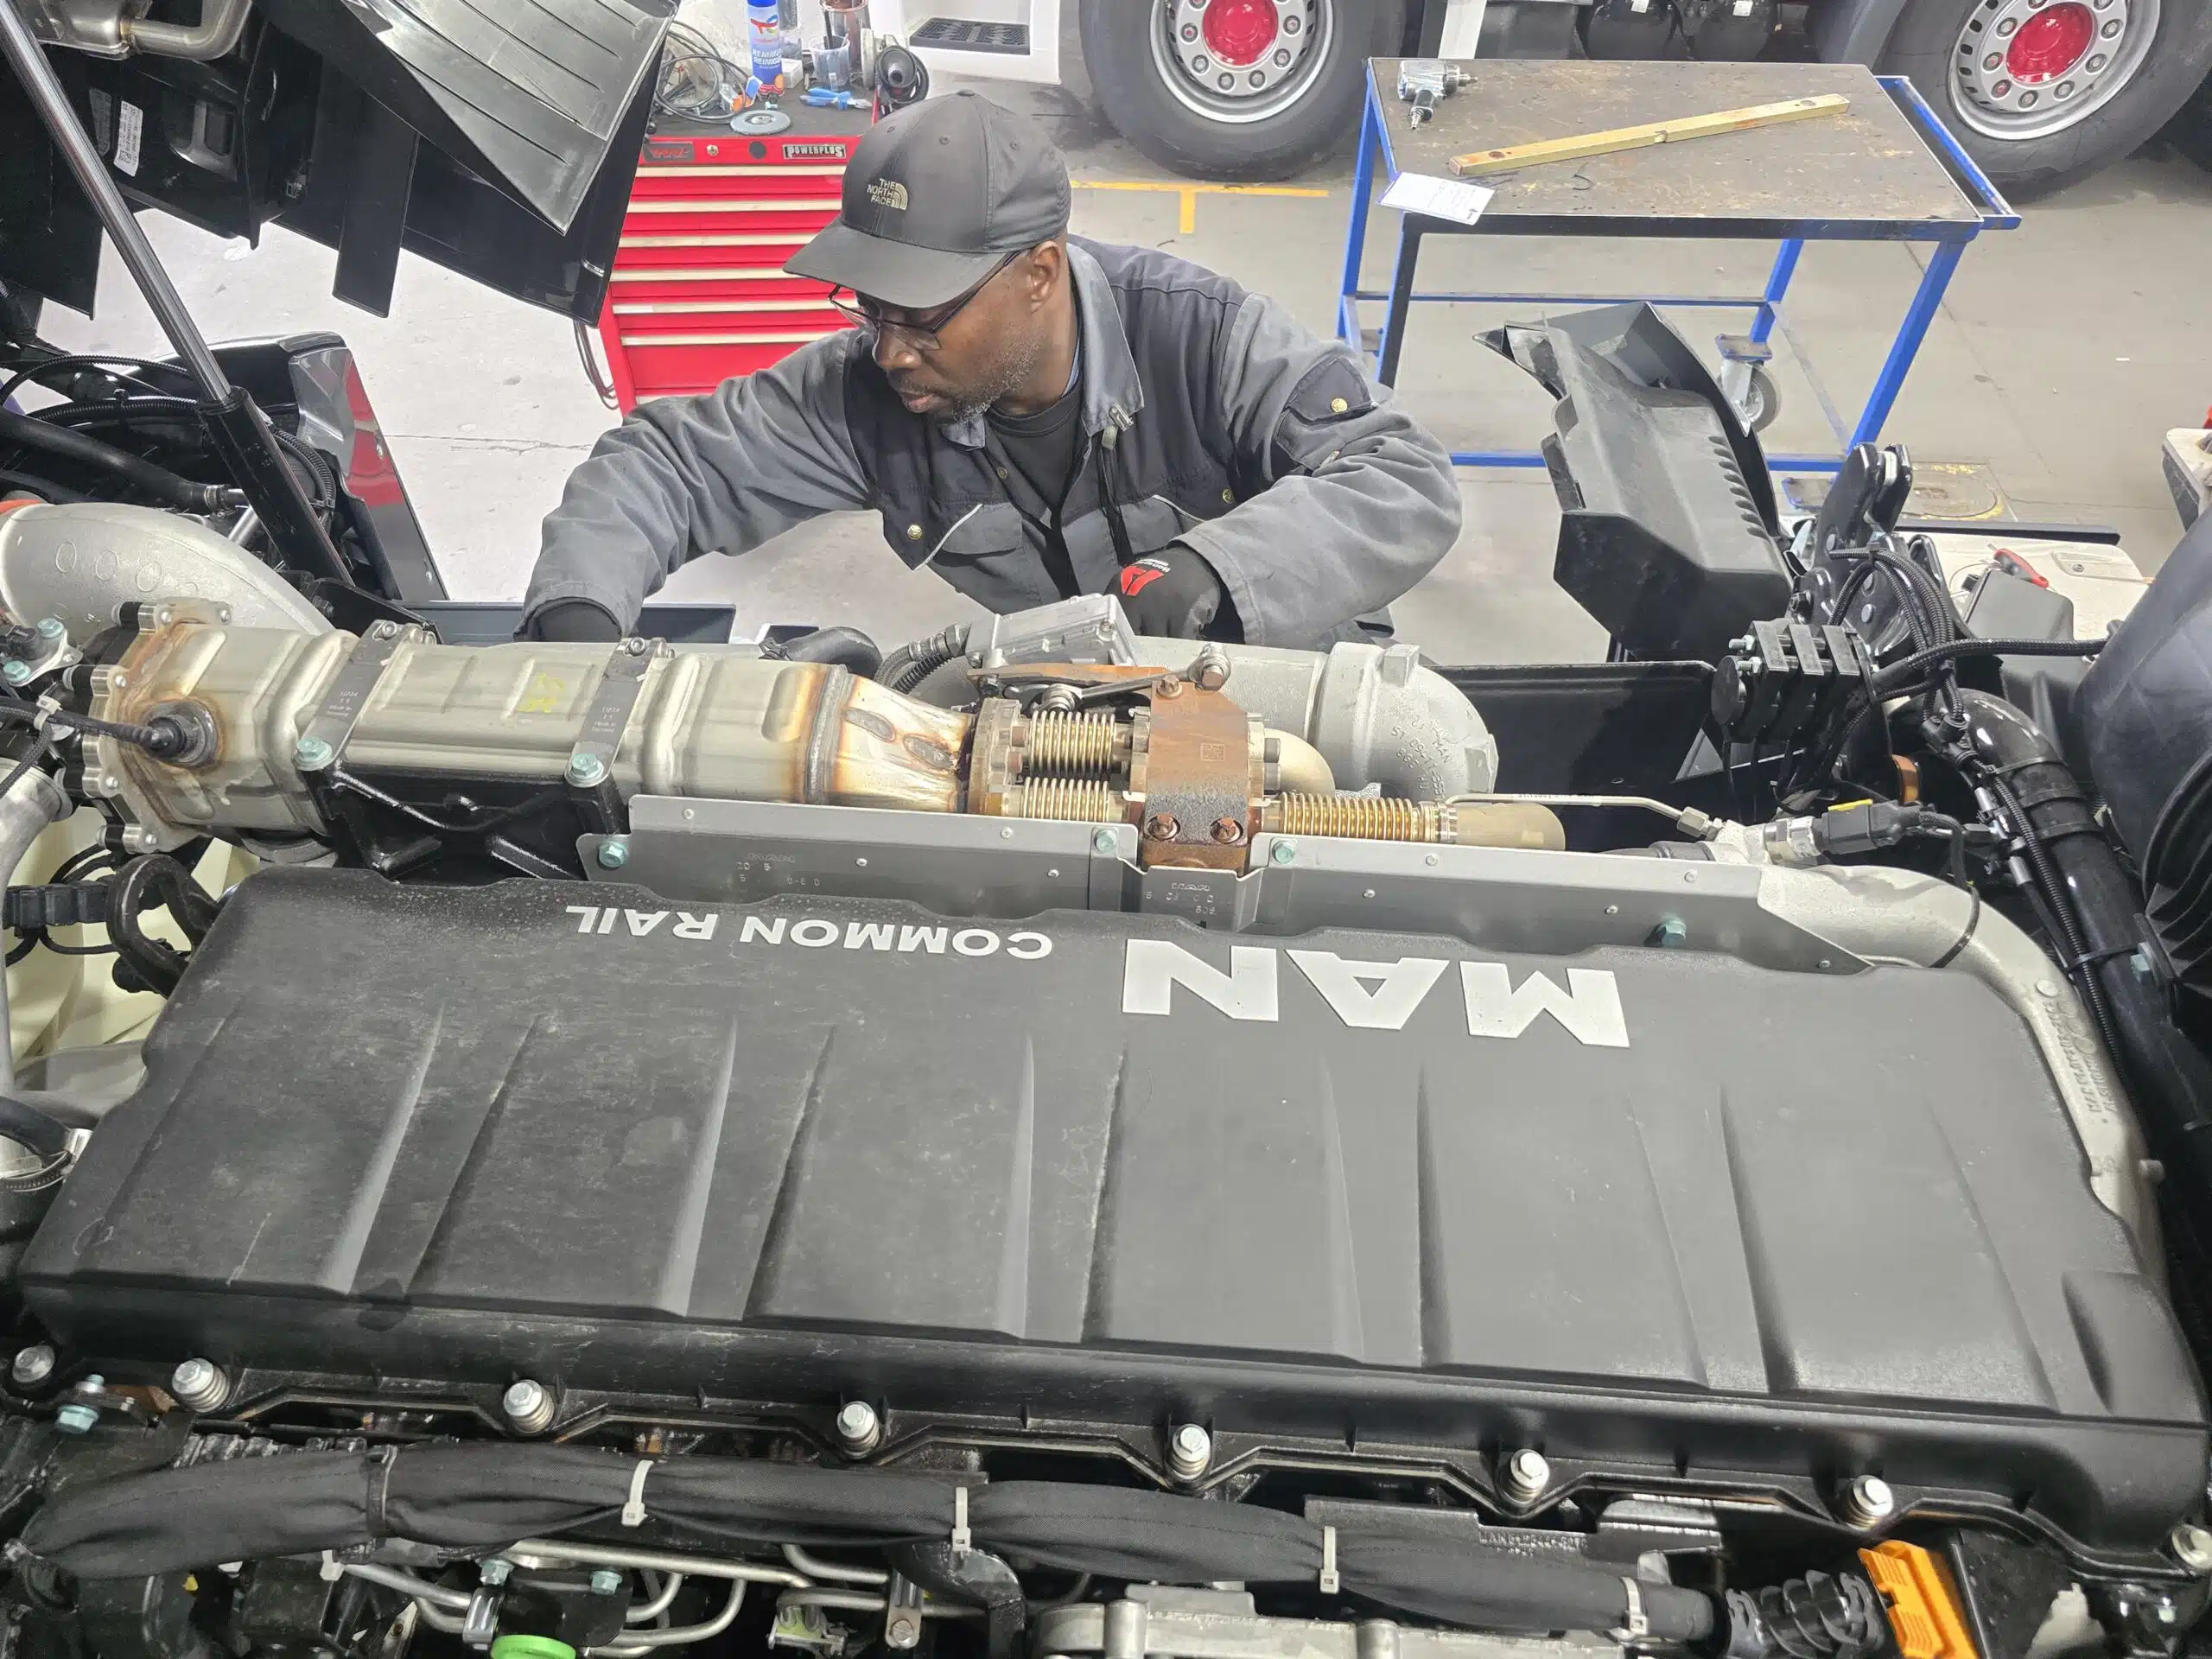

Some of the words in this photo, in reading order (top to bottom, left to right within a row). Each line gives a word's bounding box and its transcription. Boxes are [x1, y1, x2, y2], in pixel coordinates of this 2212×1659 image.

[786, 144, 844, 158] POWERPLUS
[867, 184, 894, 199] NORTH
[879, 178, 896, 190] THE
[870, 194, 892, 207] FACE
[565, 905, 719, 940] RAIL
[739, 915, 1052, 959] COMMON
[1122, 938, 1630, 1047] MAN
